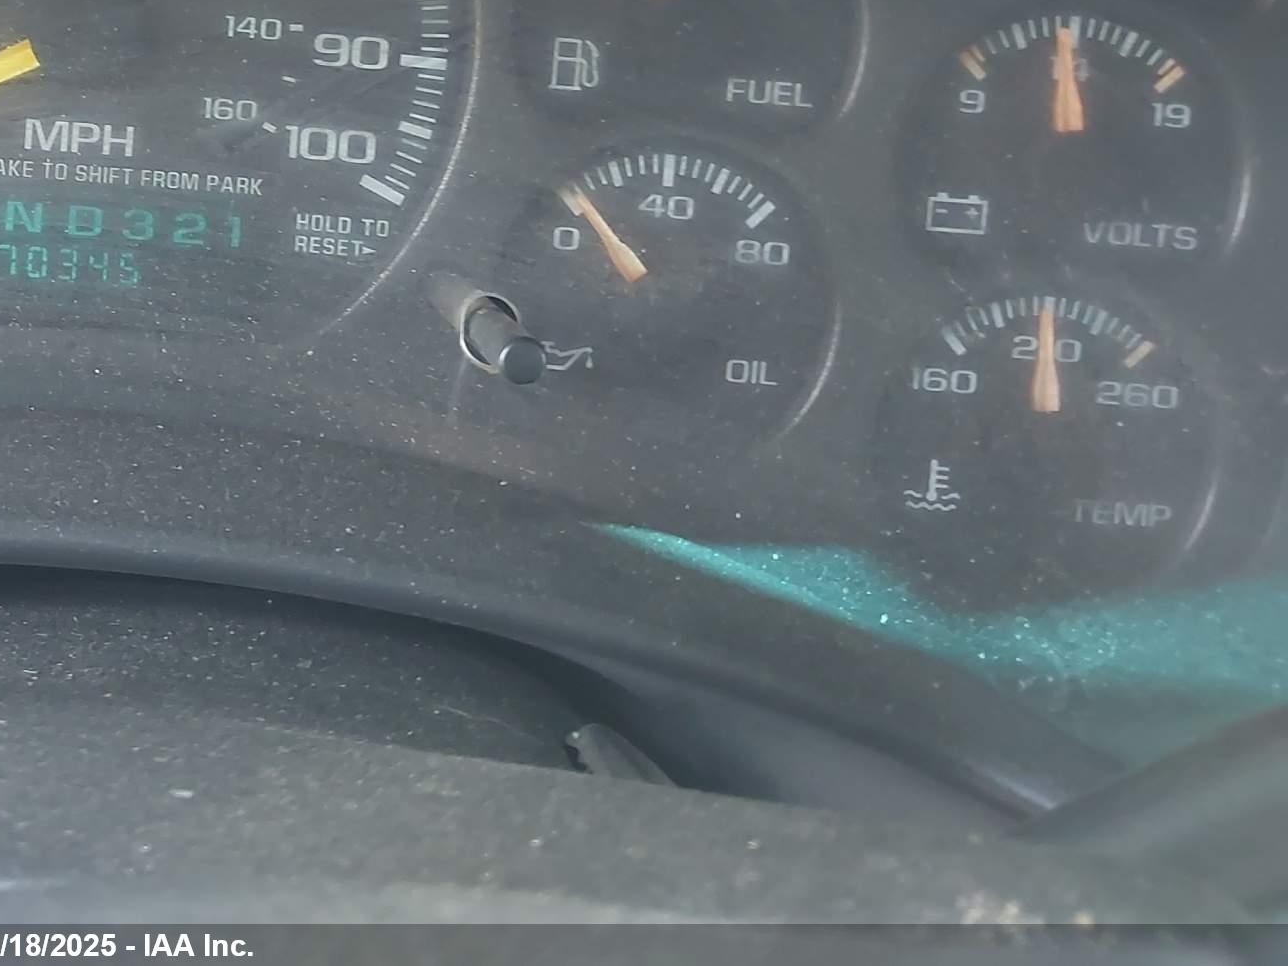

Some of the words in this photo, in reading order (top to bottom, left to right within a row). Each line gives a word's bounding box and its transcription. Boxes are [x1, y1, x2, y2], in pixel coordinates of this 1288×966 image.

[225, 15, 282, 40] 140
[312, 33, 390, 70] 90
[725, 78, 813, 107] FUEL
[959, 89, 986, 114] 9
[203, 97, 258, 121] 160
[1151, 102, 1192, 128] 19
[22, 118, 136, 157] MPH
[285, 125, 377, 164] 100
[42, 161, 68, 181] TO
[75, 165, 134, 185] SHIFT
[140, 170, 199, 190] FROM
[206, 175, 263, 196] PARK
[638, 193, 694, 220] 40
[4, 201, 43, 233] N
[68, 205, 103, 237] D
[122, 209, 154, 241] 3
[173, 213, 207, 246] 2
[228, 216, 242, 248] 1
[296, 213, 352, 234] HOLD
[361, 219, 390, 237] TO
[1083, 221, 1198, 251] VOLTS
[553, 226, 581, 251] 0
[734, 239, 790, 266] 80
[1011, 335, 1083, 363] 20
[725, 359, 778, 386] OIL
[911, 367, 978, 394] 160
[1095, 380, 1179, 409] 260
[1070, 499, 1173, 527] TEMP
